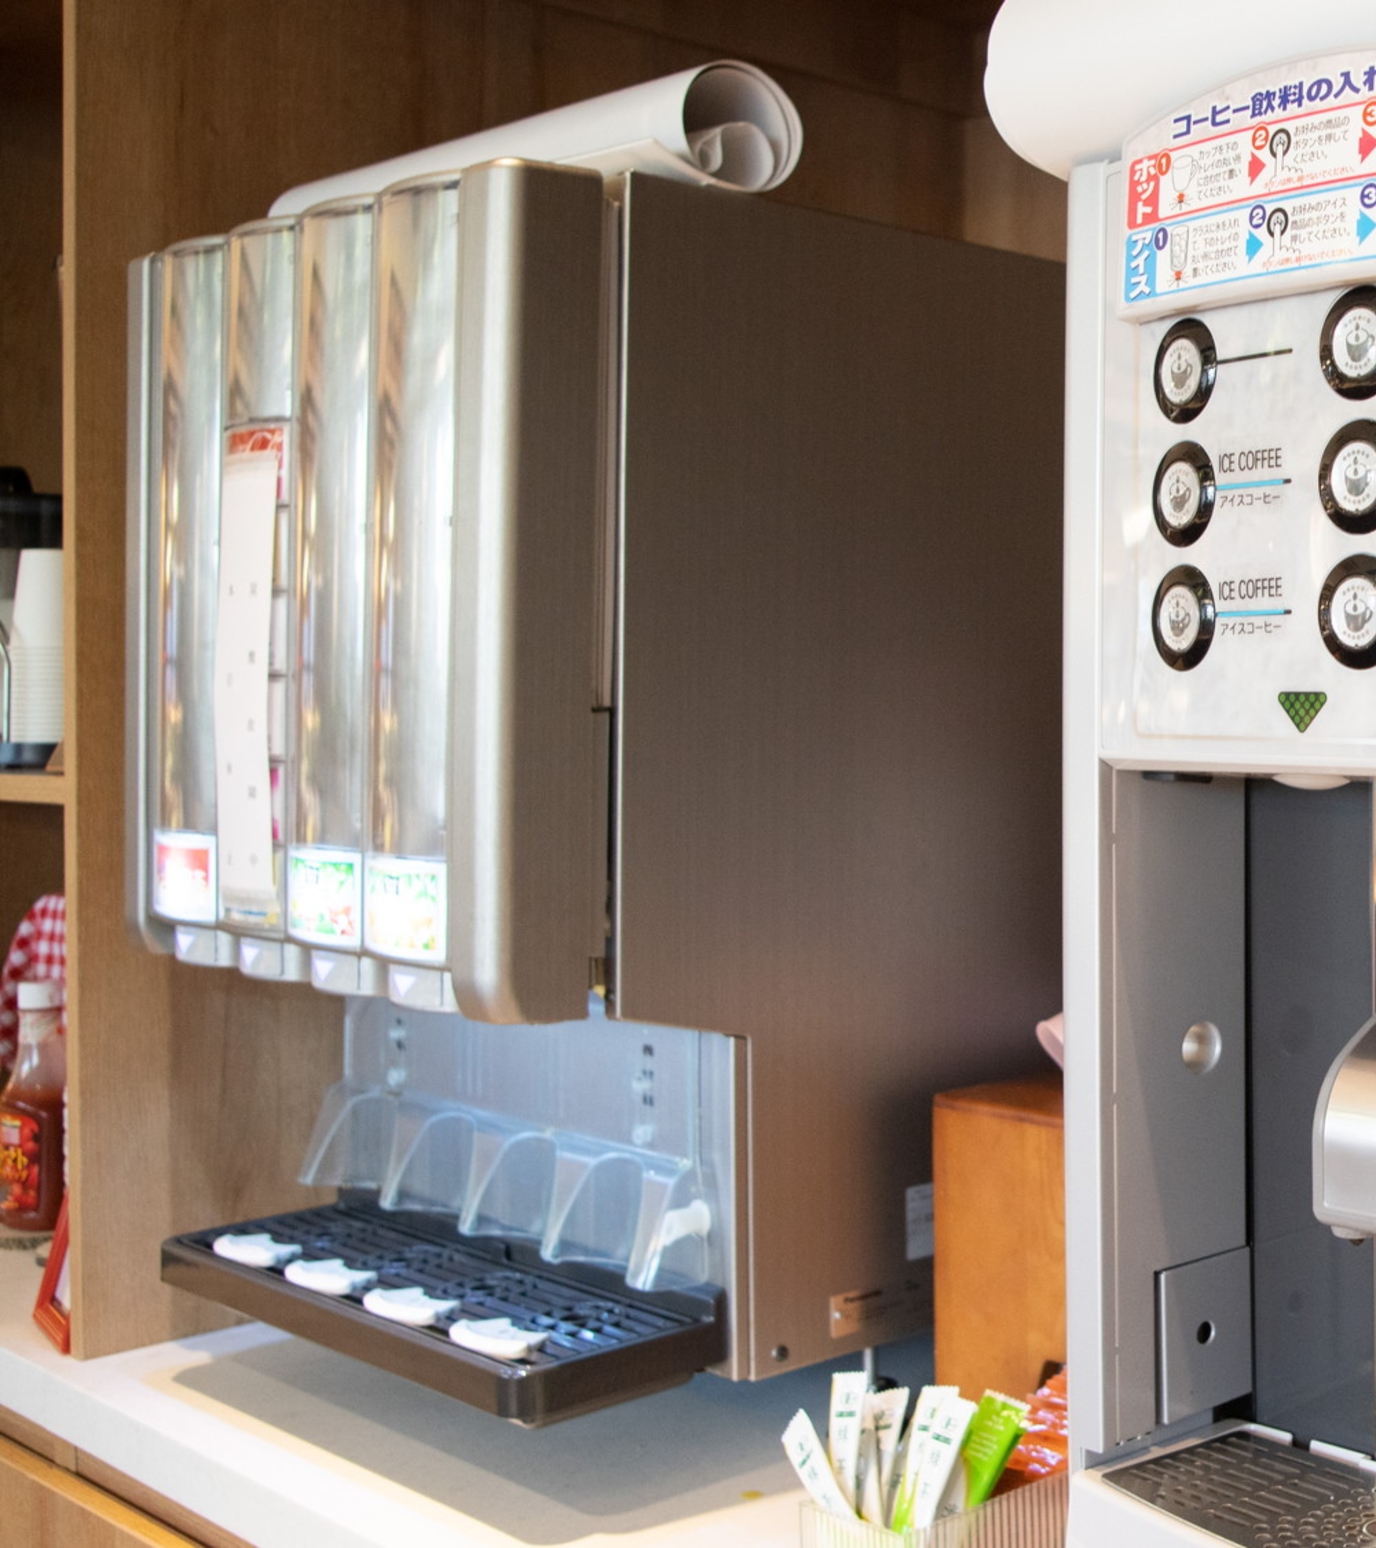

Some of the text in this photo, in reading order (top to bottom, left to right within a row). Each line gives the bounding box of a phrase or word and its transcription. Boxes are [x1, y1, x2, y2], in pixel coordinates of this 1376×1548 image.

[1293, 116, 1350, 136] お好みの商品の
[1293, 130, 1349, 149] ボタンを押して
[1293, 148, 1328, 164] ください。
[1133, 157, 1157, 224] ホット
[1291, 197, 1347, 217] お好みのアイス
[1291, 213, 1346, 231] 商品のボタンを
[1291, 227, 1350, 245] 押してください。
[1129, 232, 1153, 299] アイス
[1218, 447, 1282, 473] ICE COFFEE
[1220, 493, 1281, 509] アイスコーヒー
[1218, 577, 1282, 601] ICE COFFEE
[1221, 622, 1282, 636] アイスコーヒー
